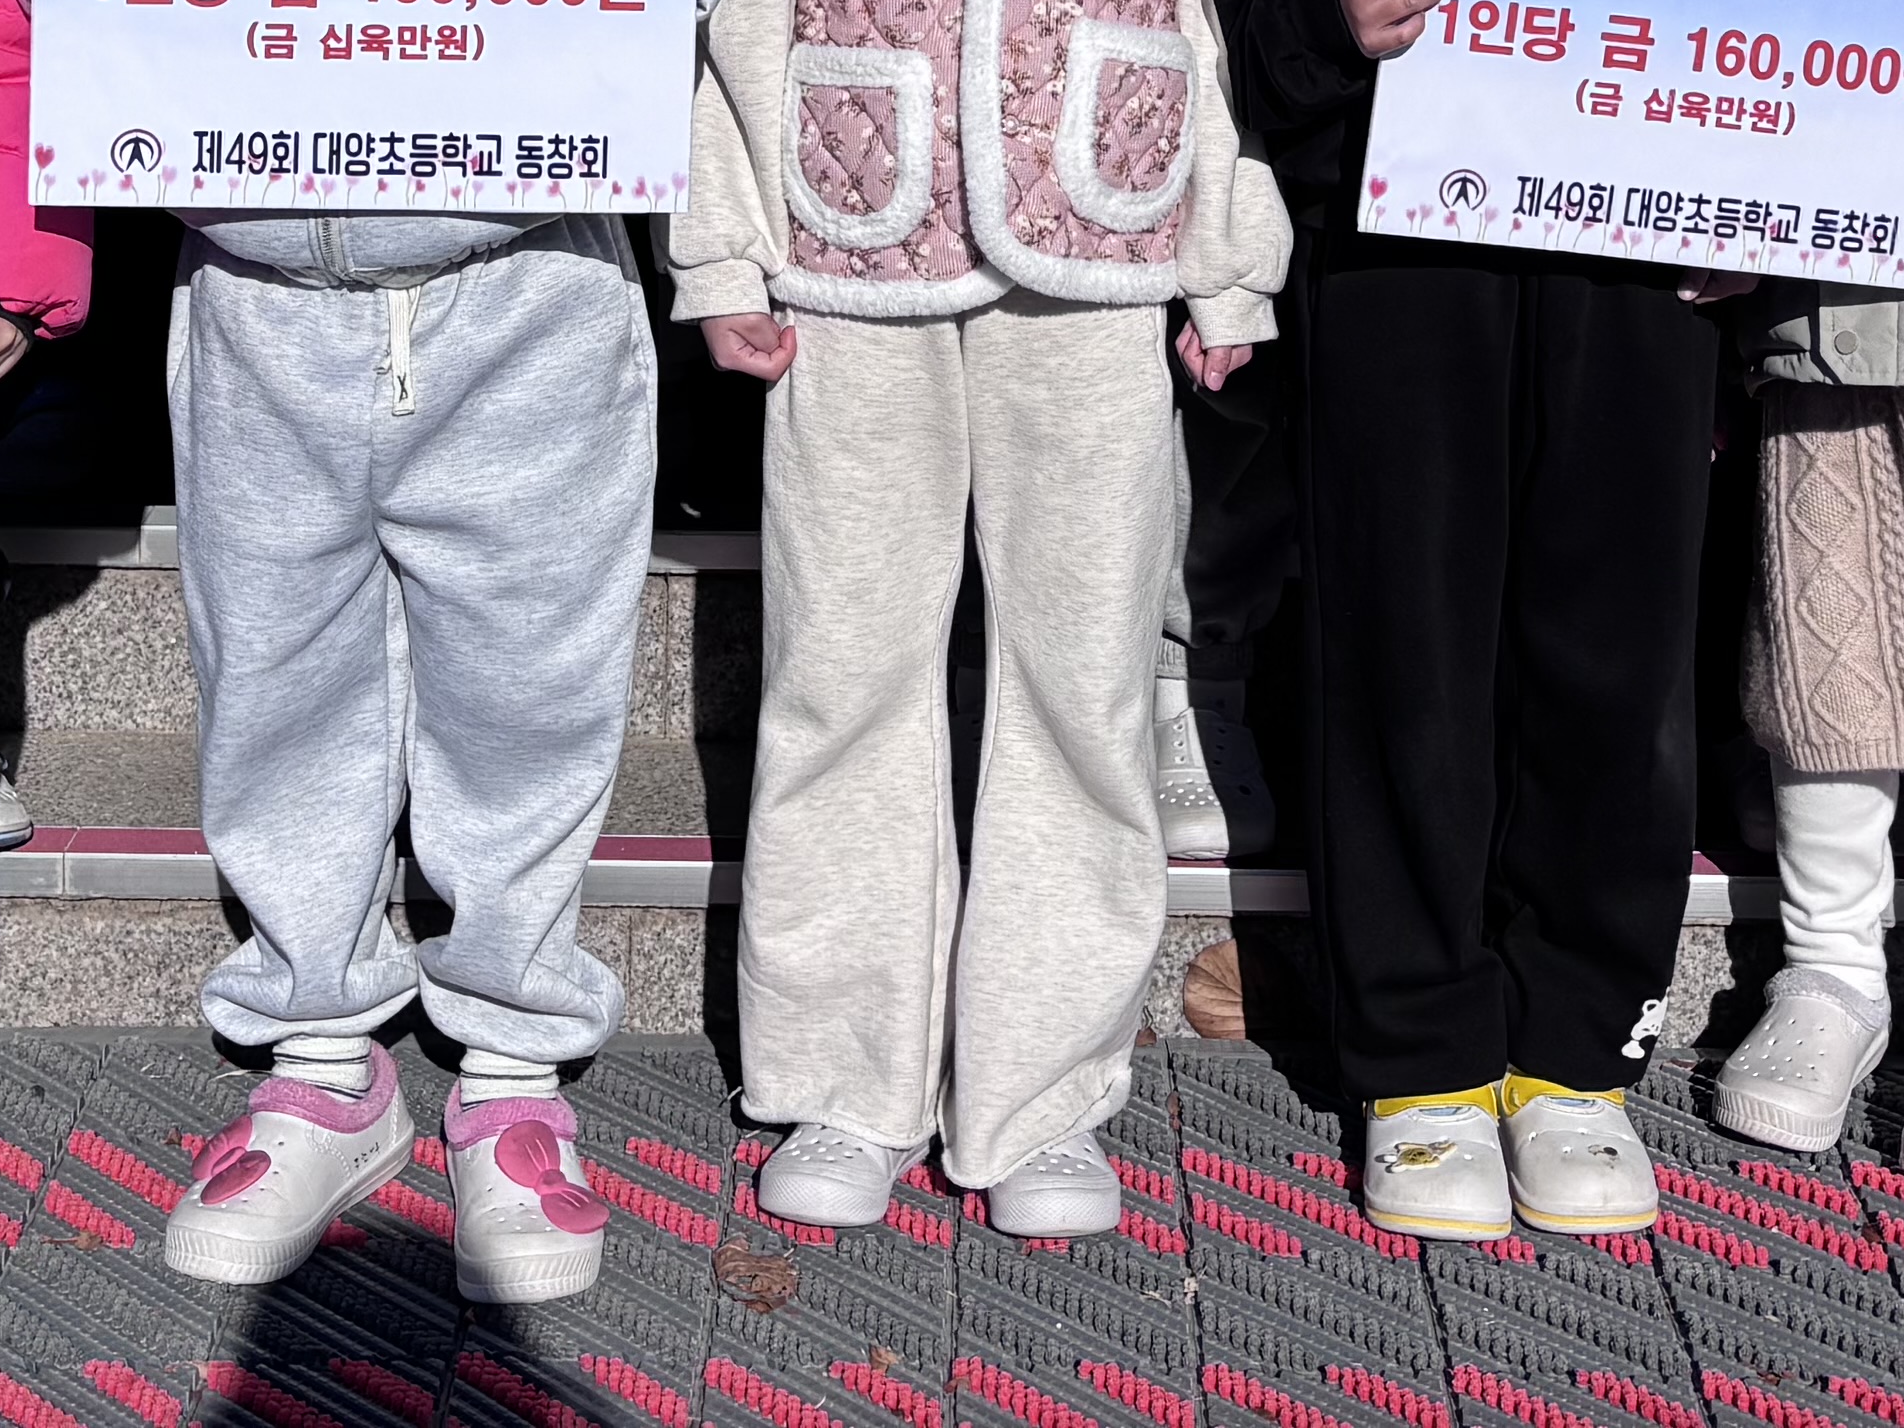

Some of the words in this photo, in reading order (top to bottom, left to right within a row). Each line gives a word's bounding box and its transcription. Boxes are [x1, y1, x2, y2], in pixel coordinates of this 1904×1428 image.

[246, 21, 298, 59] (금
[320, 22, 486, 61] 십육만원)
[1599, 14, 1655, 72] 금
[1575, 79, 1624, 117] (금
[1643, 88, 1797, 135] 십육만원)
[193, 129, 299, 176] 제49회
[312, 130, 505, 179] 대양초등학교
[514, 133, 609, 179] 동창회
[1512, 173, 1615, 221] 제49회
[1623, 185, 1801, 245] 대양초등학교
[1810, 206, 1900, 255] 동창회
